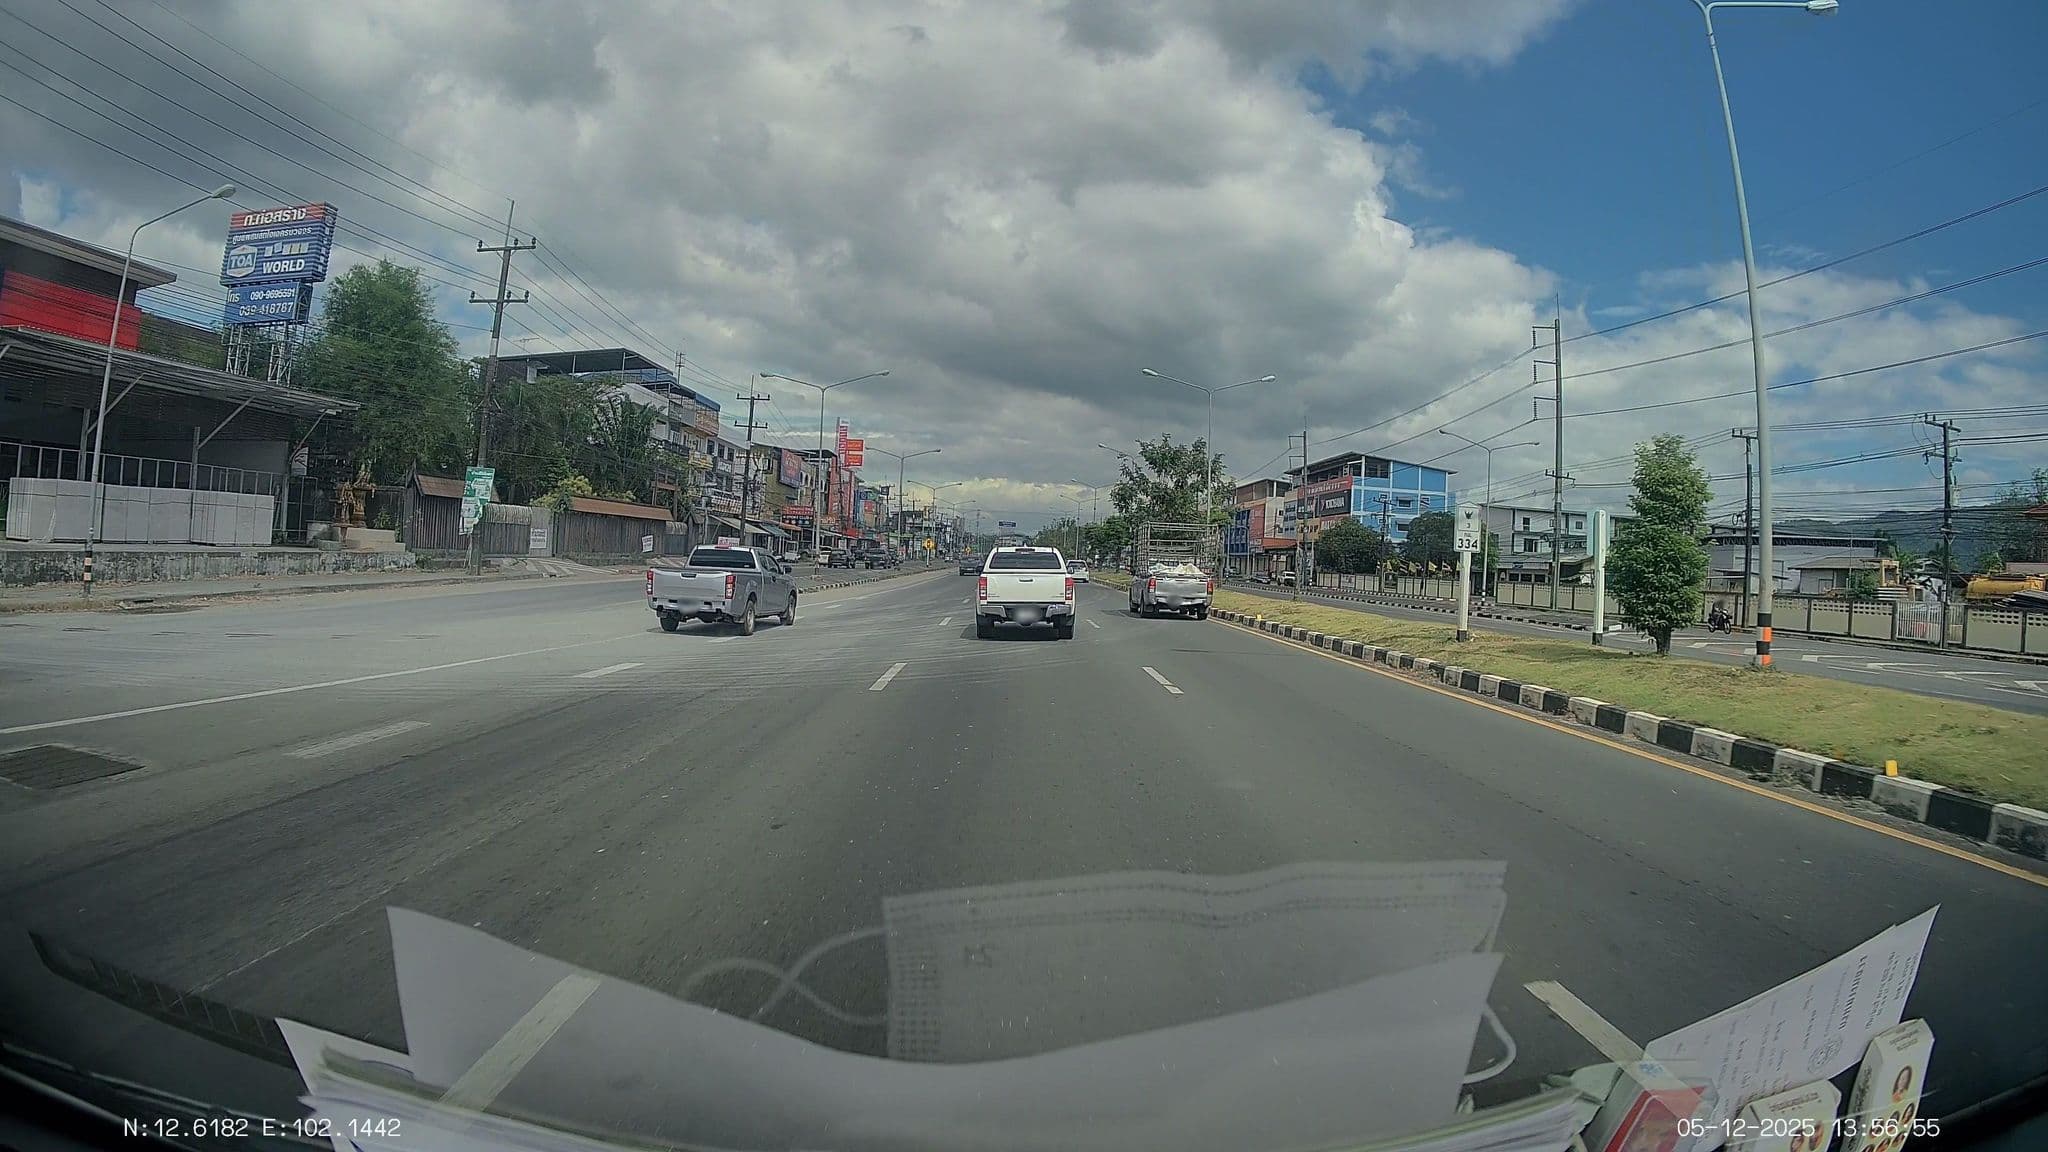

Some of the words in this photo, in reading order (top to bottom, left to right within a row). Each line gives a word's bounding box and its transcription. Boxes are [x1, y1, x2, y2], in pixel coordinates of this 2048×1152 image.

[244, 207, 307, 226] ก.ก่อสร้าง
[230, 254, 253, 269] TOA
[263, 259, 305, 274] WORLD
[1457, 538, 1478, 550] 334
